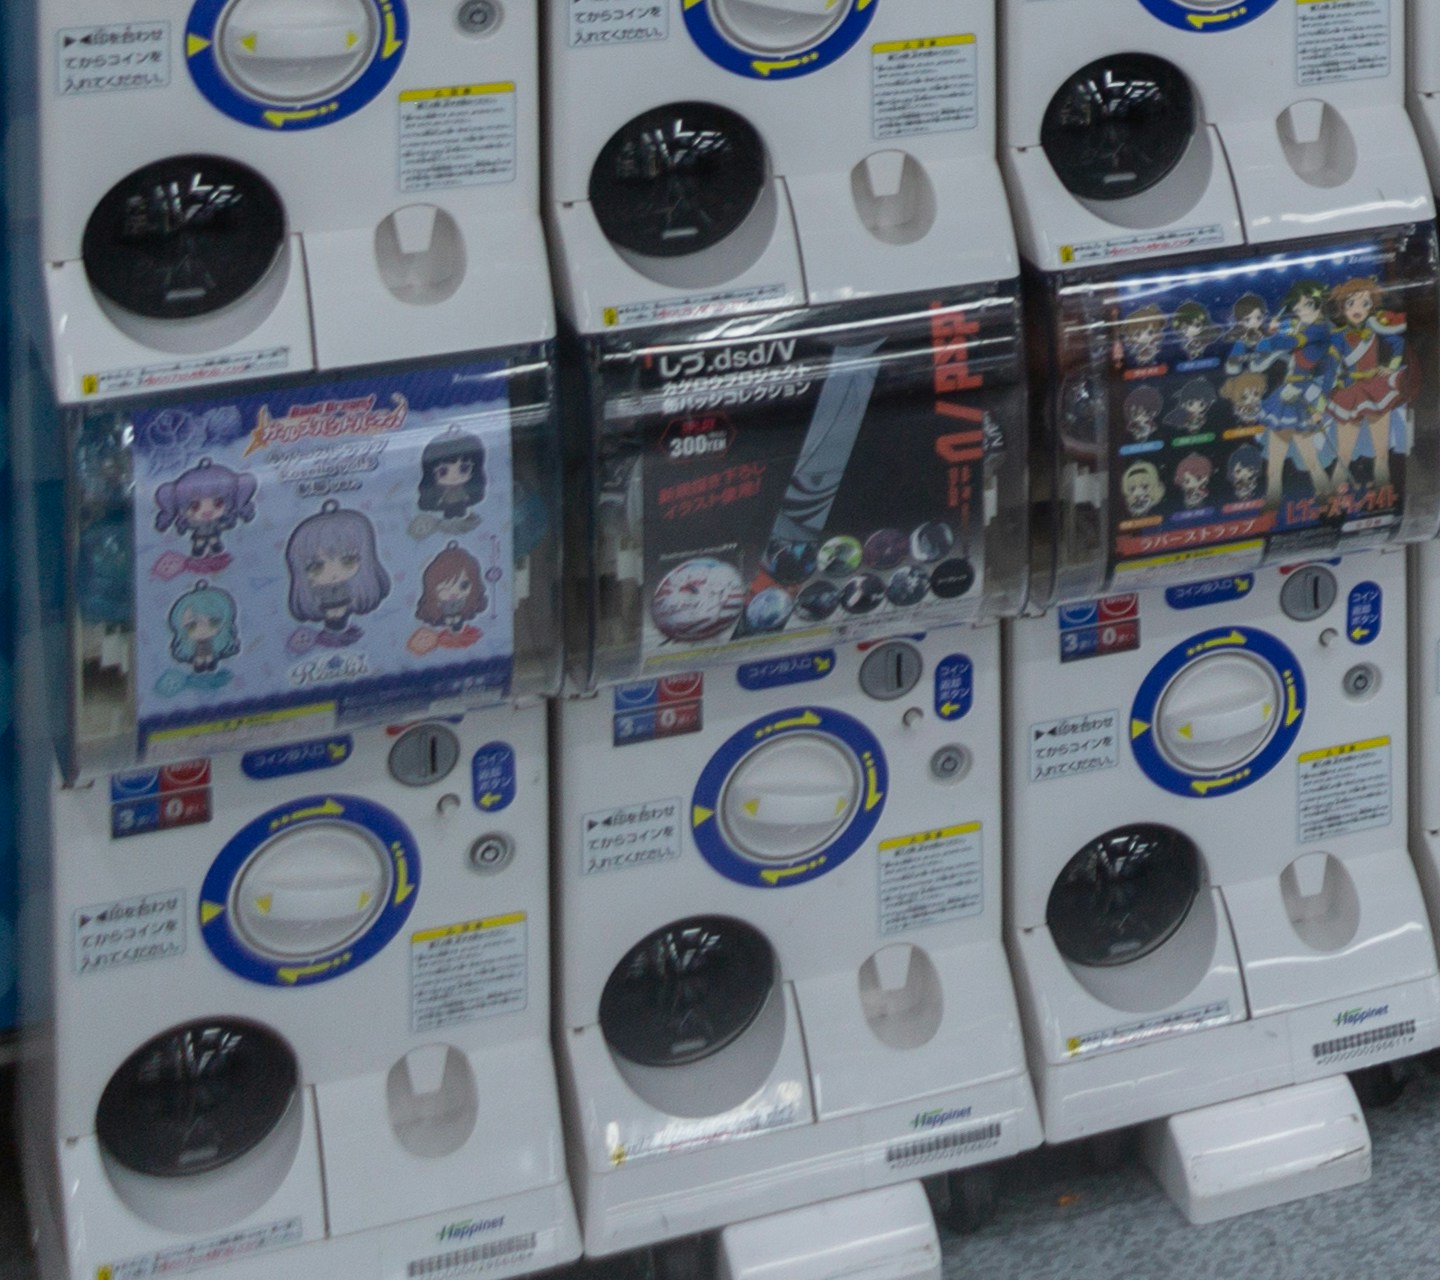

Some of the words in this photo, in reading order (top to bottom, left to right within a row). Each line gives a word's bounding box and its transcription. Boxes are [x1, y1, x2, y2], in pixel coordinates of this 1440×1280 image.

[575, 6, 662, 23] てからコインを
[1140, 519, 1256, 551] ラバーストラップ
[1333, 1005, 1389, 1027] Happinet
[910, 1104, 973, 1129] Happinet
